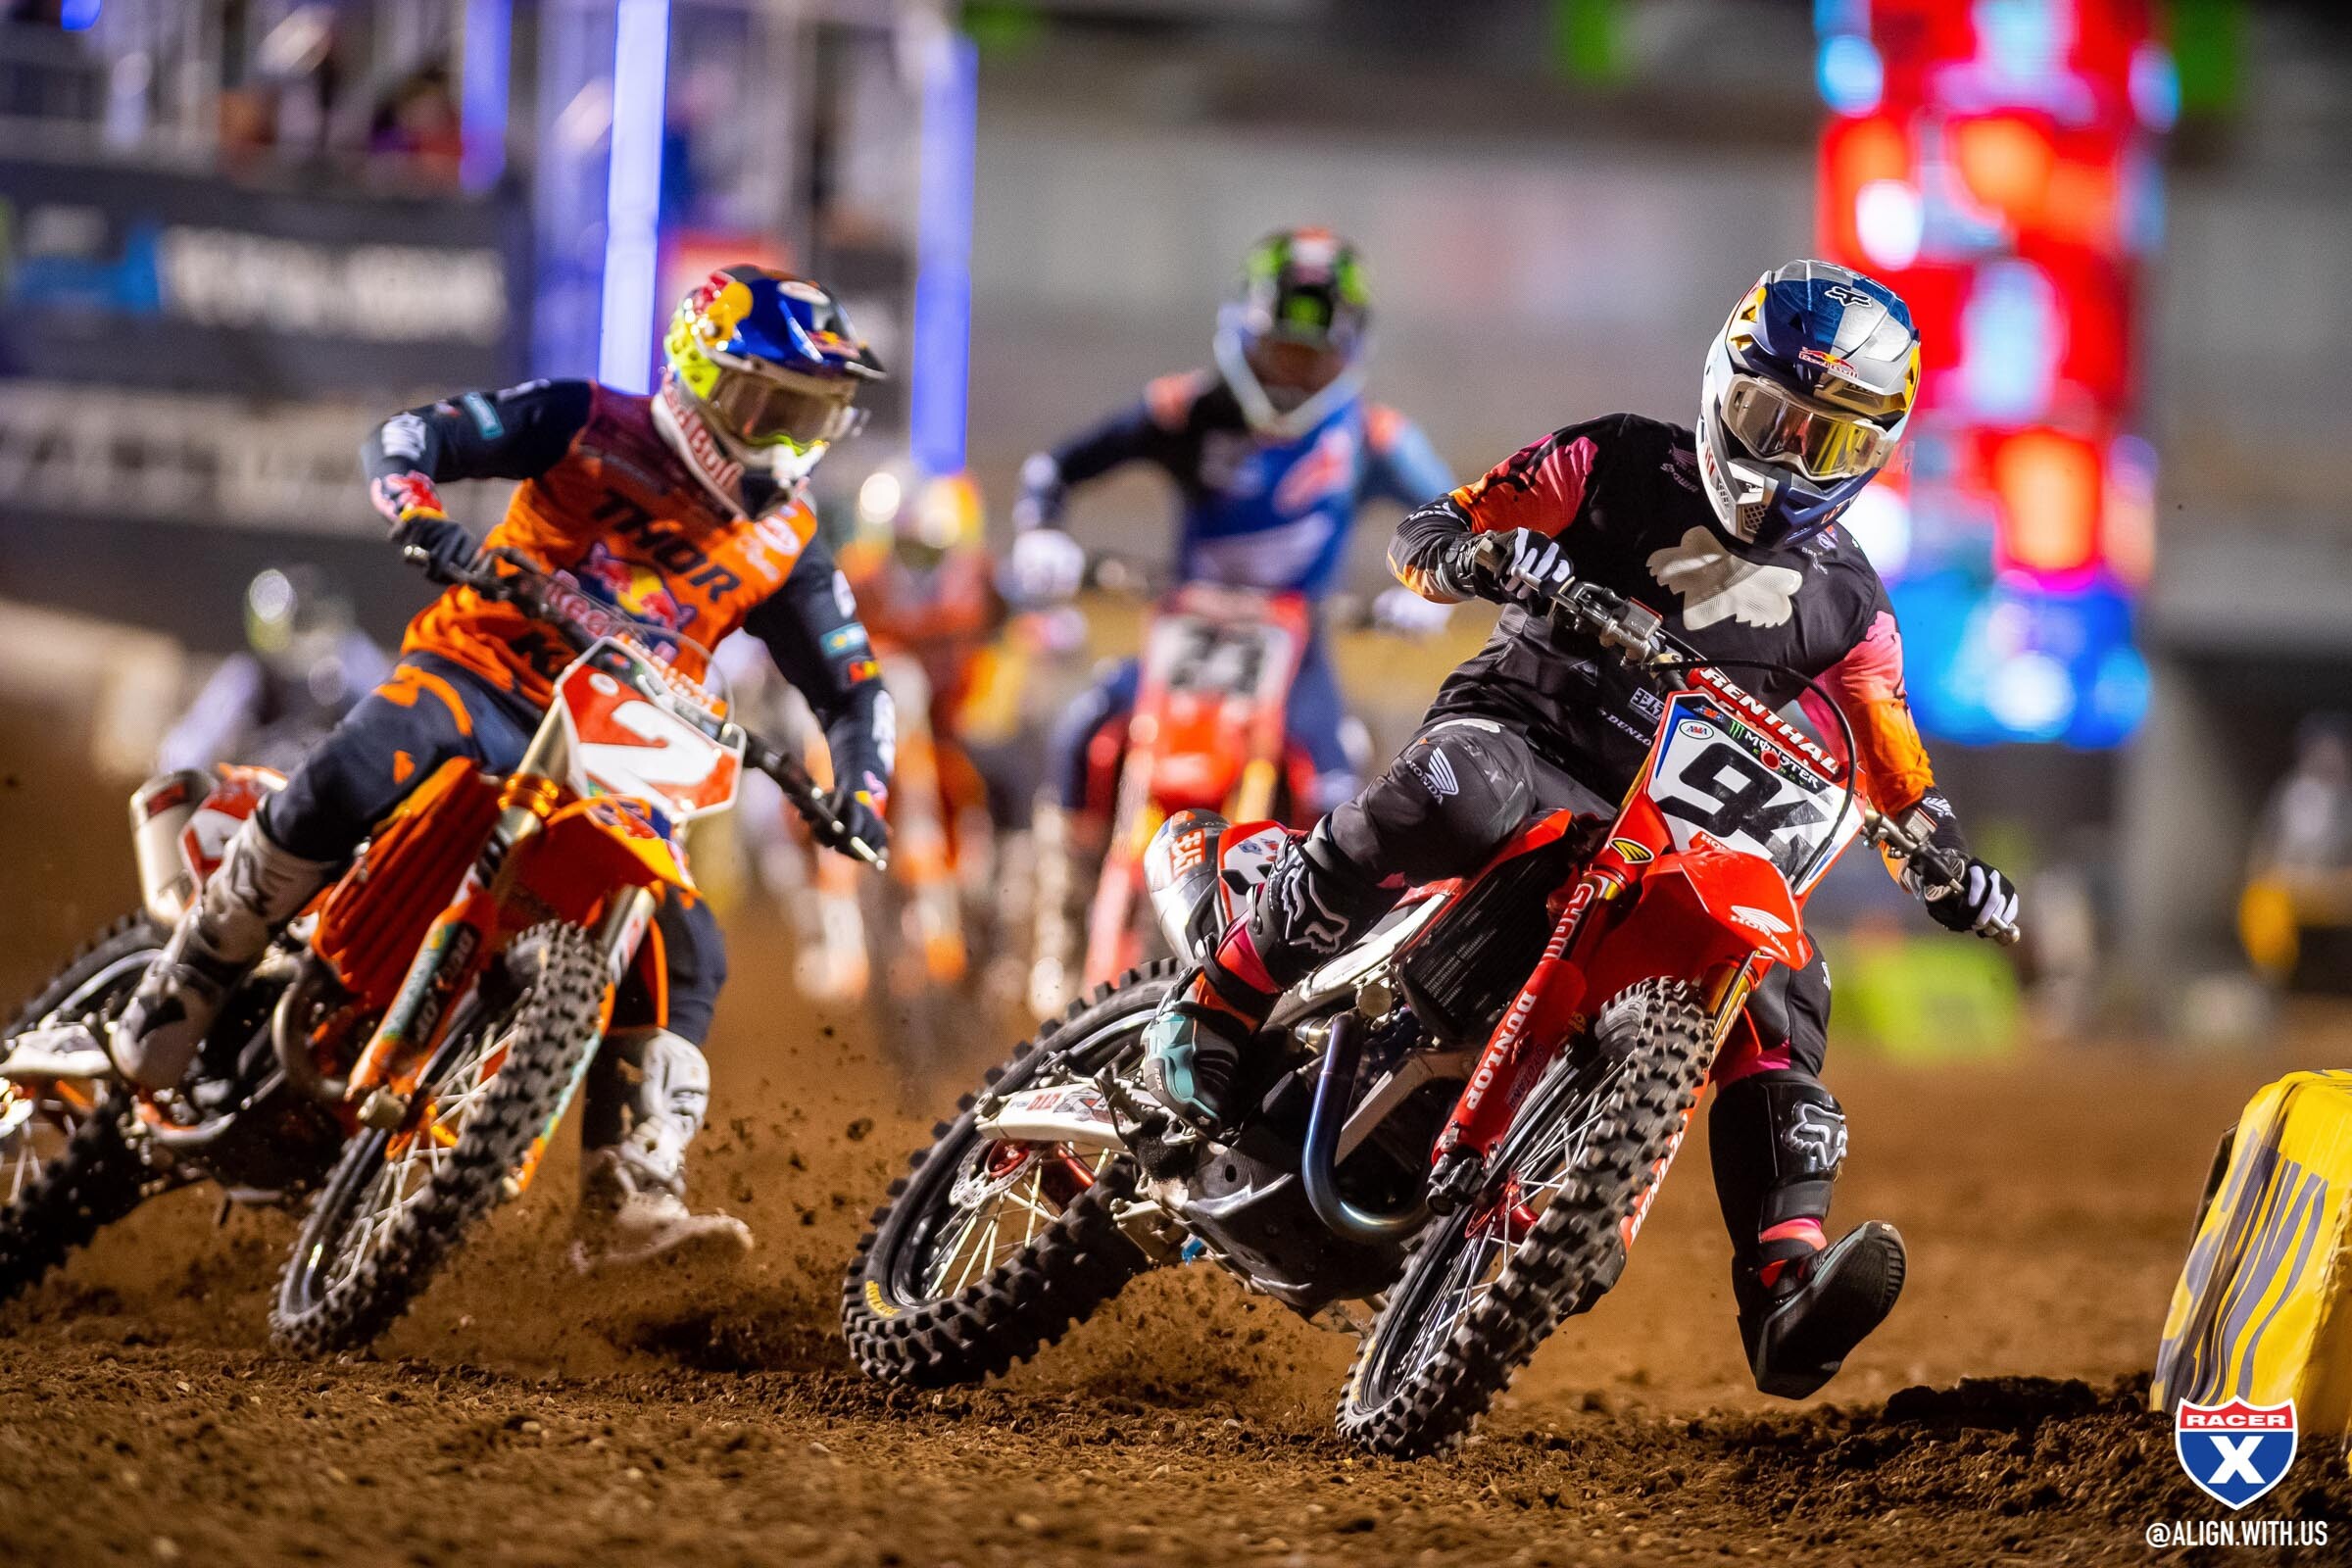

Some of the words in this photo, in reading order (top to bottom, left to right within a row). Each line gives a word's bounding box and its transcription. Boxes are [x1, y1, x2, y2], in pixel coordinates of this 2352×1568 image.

[592, 488, 742, 603] THOR
[1607, 713, 1652, 747] DUNLO
[1699, 667, 1840, 774] RENTHAL
[1744, 731, 1820, 788] MONSTER
[1752, 748, 1805, 786] ERGY
[1543, 883, 1594, 960] SHOW
[1730, 915, 1791, 959] HONDA
[1466, 990, 1538, 1110] DUNLOP
